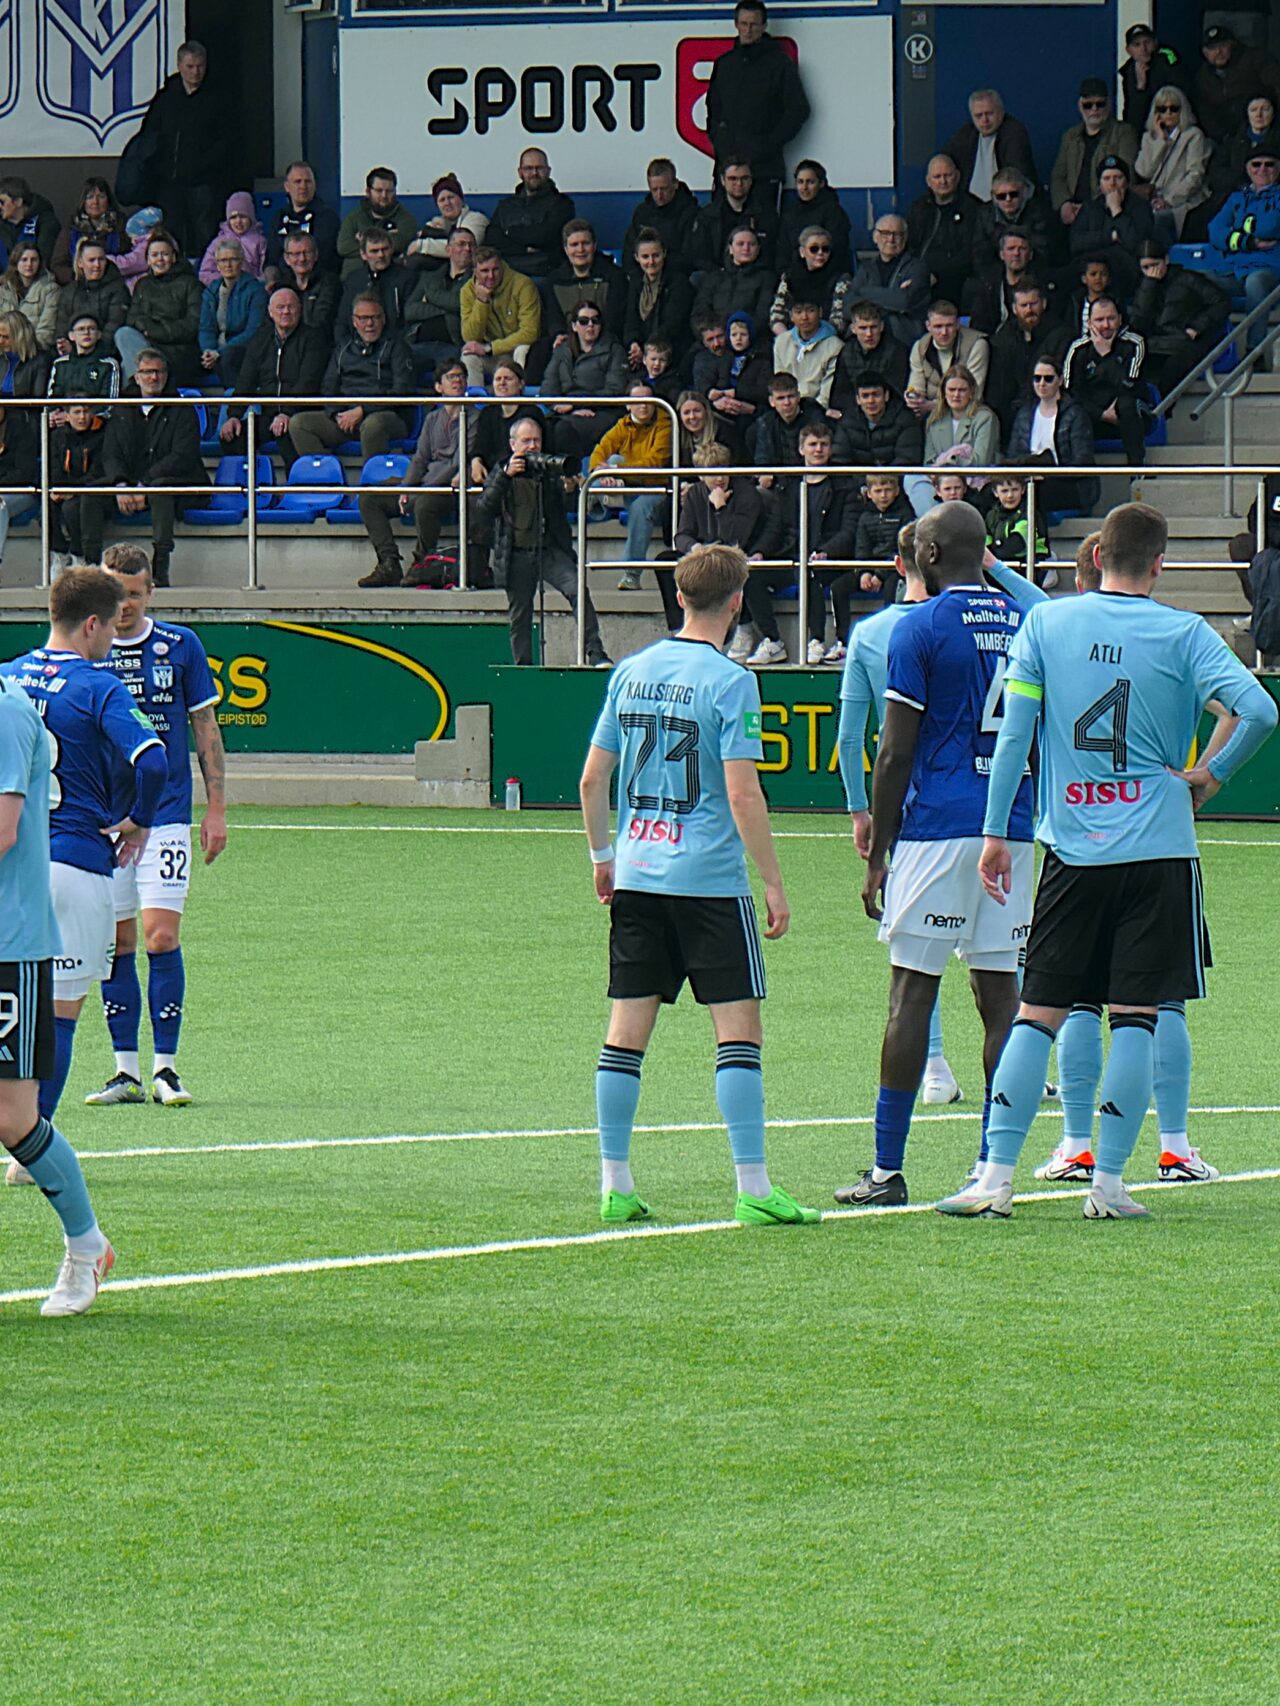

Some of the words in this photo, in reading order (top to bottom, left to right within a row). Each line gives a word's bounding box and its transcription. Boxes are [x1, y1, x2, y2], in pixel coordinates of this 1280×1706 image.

[427, 63, 662, 135] SPORT
[962, 610, 1008, 625] Malltek
[1089, 643, 1123, 665] ATLI
[127, 684, 143, 695] BI
[1075, 679, 1131, 773] 4
[619, 713, 701, 815] 23
[1065, 780, 1143, 806] SISU
[628, 817, 685, 844] SISU
[160, 849, 187, 880] 32
